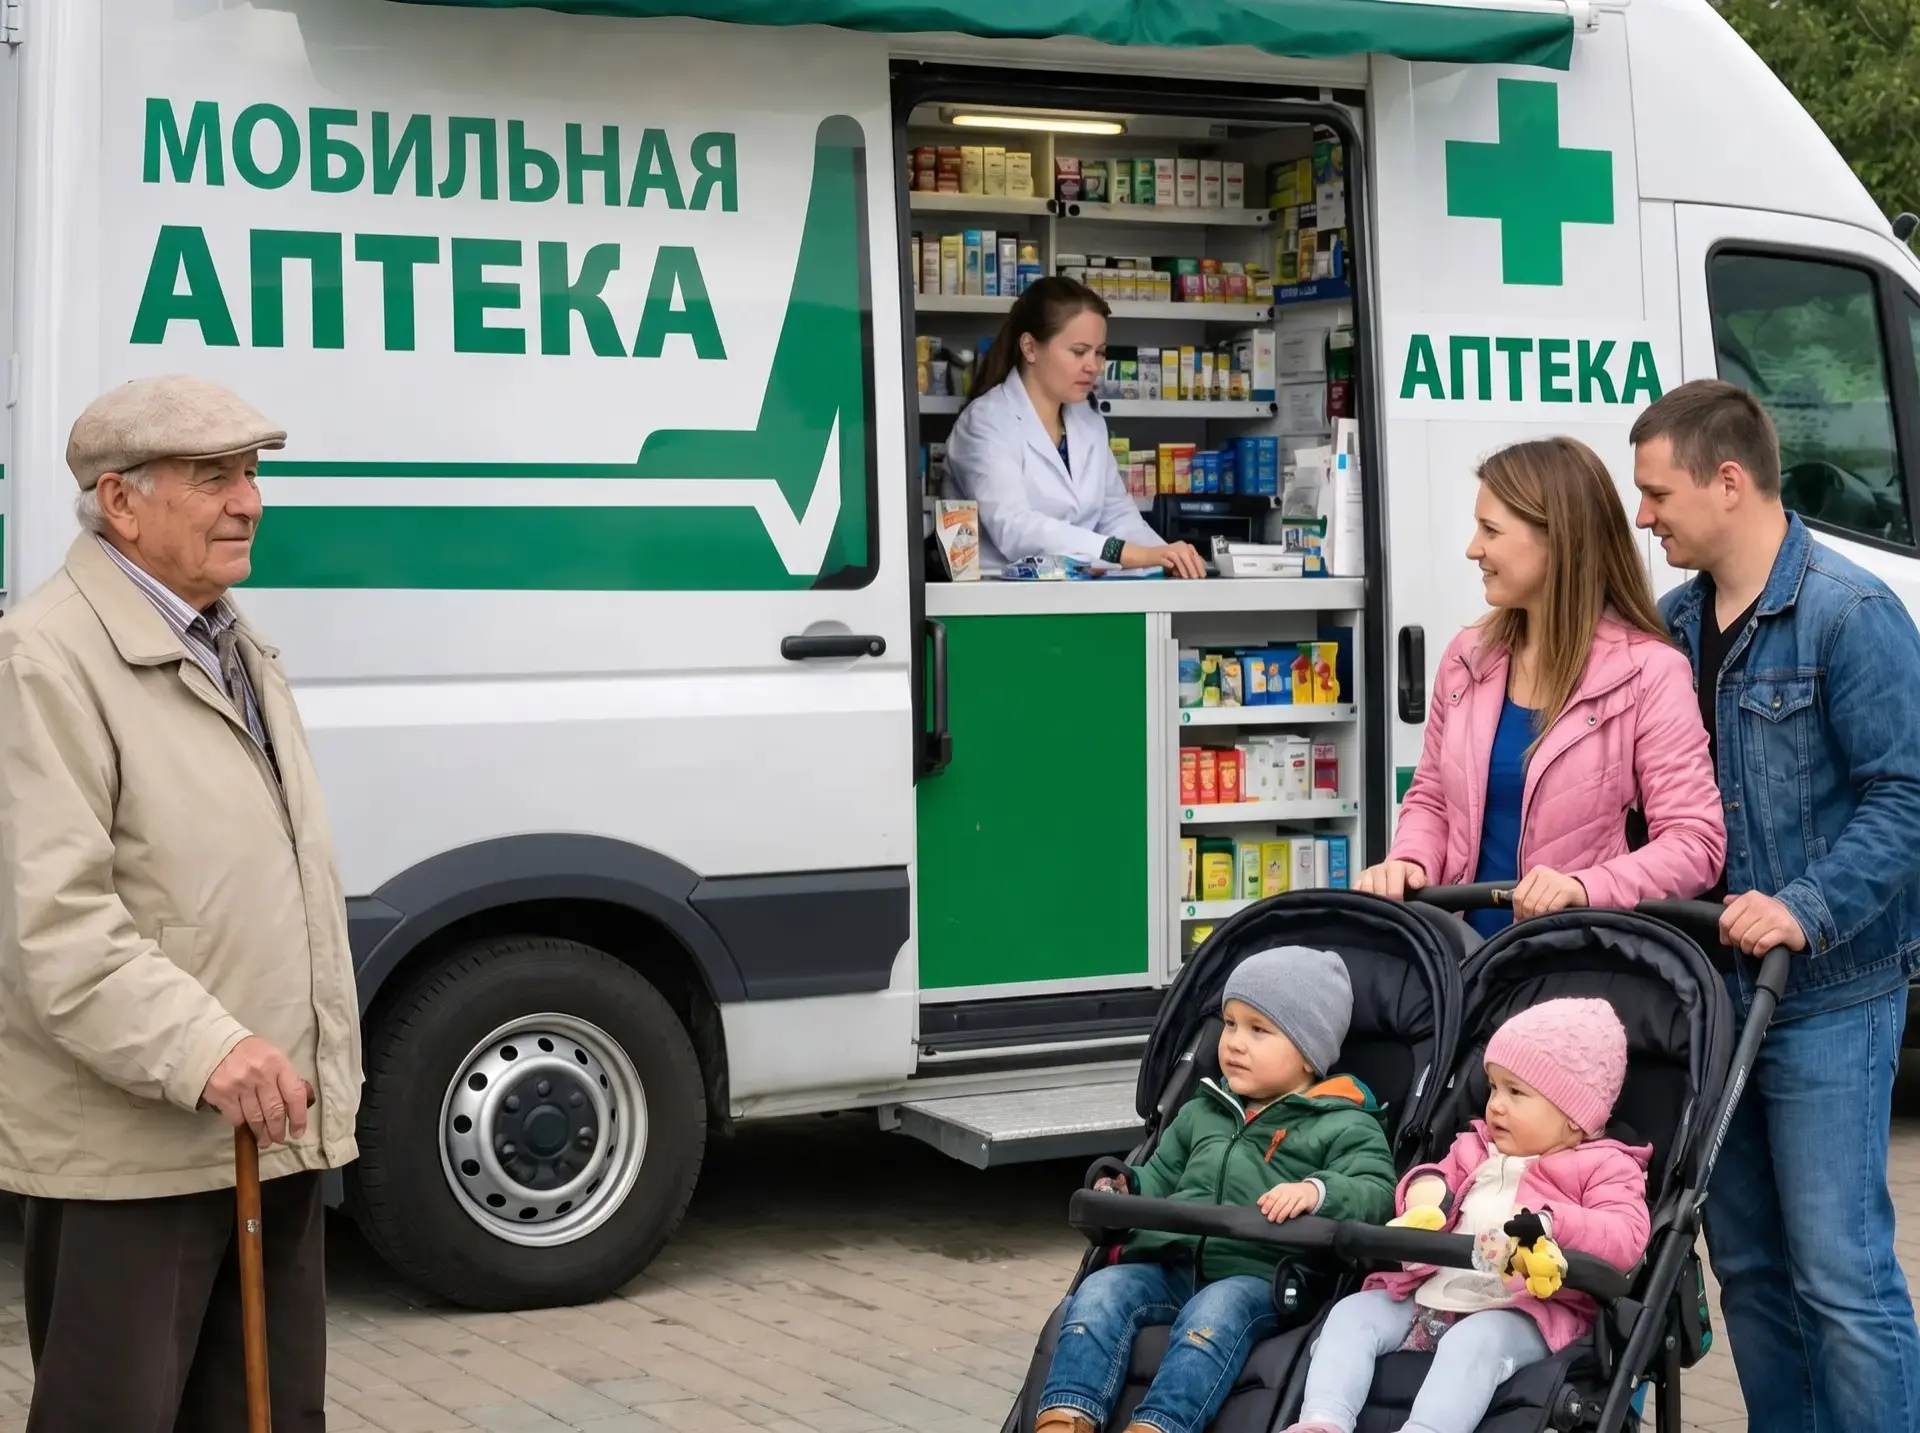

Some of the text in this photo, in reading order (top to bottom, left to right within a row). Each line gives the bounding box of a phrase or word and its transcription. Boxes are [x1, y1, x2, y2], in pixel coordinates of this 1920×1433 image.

[143, 97, 739, 213] МОБИЛЬНАЯ
[129, 224, 728, 361] АПТЕКА
[1400, 333, 1664, 405] АПТЕКА
